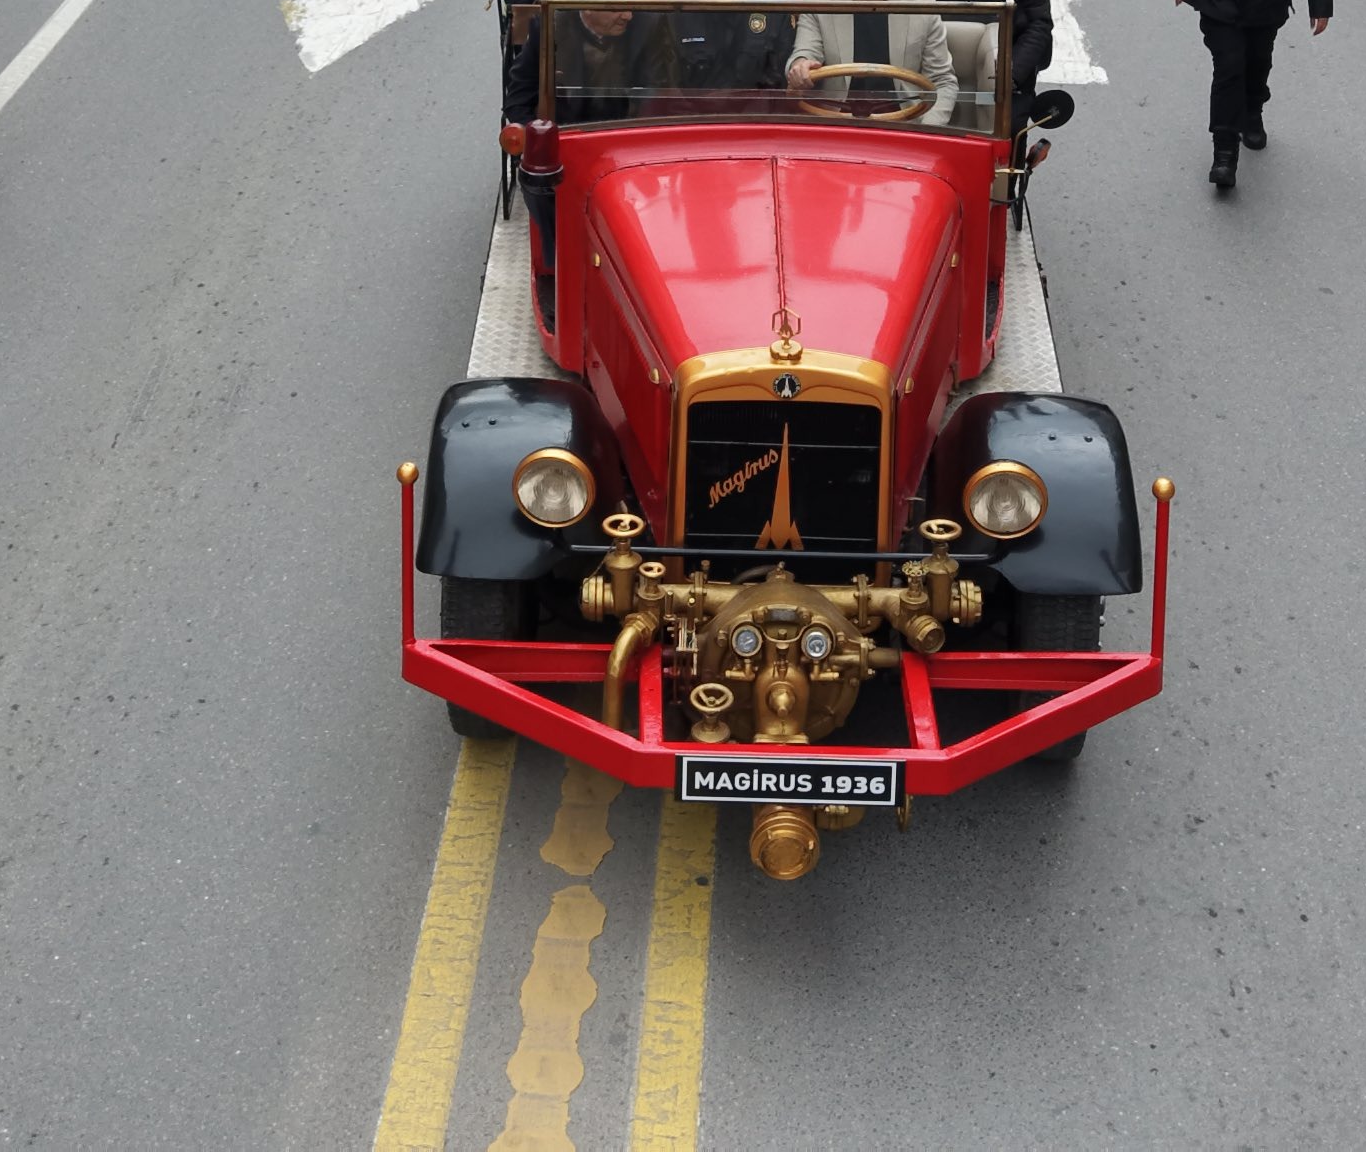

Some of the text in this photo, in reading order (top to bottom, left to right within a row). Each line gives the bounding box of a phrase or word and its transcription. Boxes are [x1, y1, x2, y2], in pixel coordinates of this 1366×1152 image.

[707, 447, 780, 512] Magirus
[693, 768, 886, 795] MAGİRUS 1936
